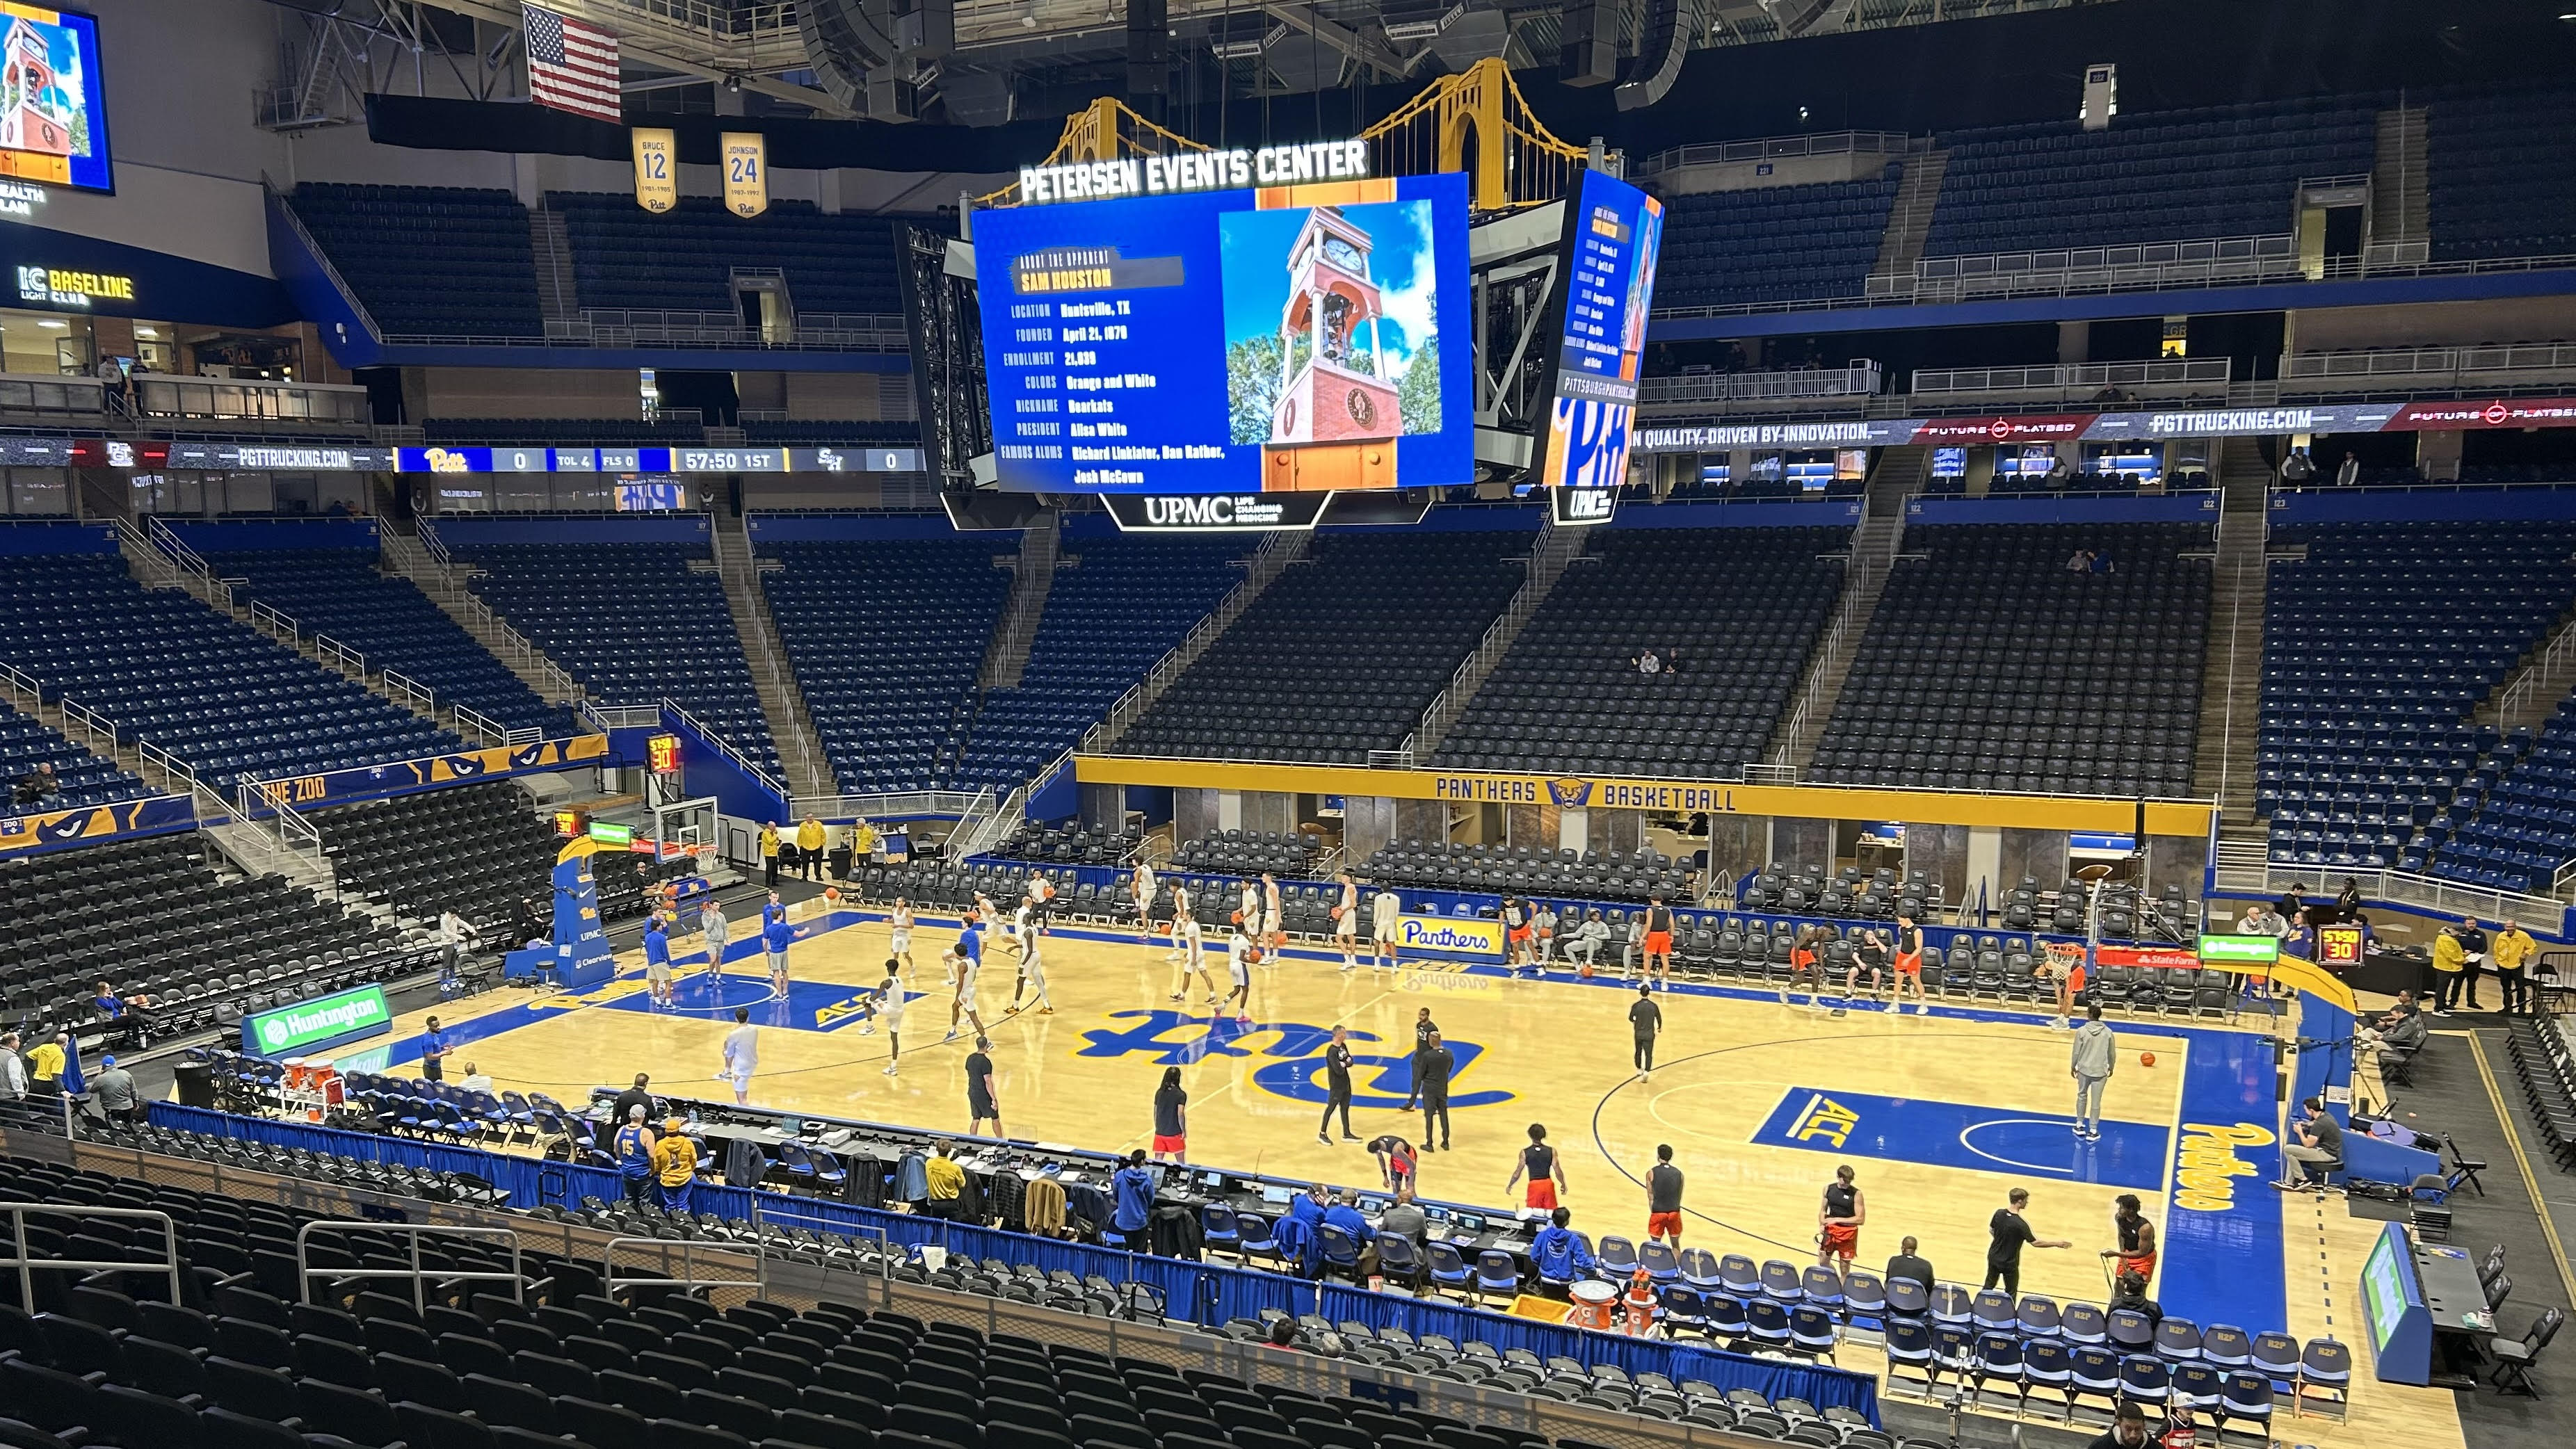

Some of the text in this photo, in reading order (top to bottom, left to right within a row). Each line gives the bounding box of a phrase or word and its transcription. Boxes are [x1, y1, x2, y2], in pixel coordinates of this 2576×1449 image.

[642, 142, 665, 151] BRUCE
[727, 147, 758, 155] JOHNSON
[643, 153, 666, 179] 12
[730, 157, 757, 183] 24
[1020, 140, 1369, 202] PETERSEN EVENTS CENTER
[647, 199, 666, 209] Pitt
[737, 203, 755, 213] Pitt
[1067, 250, 1109, 266] OPPONENT
[49, 269, 134, 299] BASELINE
[1021, 268, 1111, 291] SAM HOUSTON
[20, 291, 47, 300] LIGHT
[1011, 303, 1051, 318] LOCATION
[1061, 300, 1131, 318] Huntsville, TX
[1016, 327, 1052, 342] FOUNDED
[1063, 327, 1086, 343] April
[1088, 326, 1103, 342] 21,
[1004, 351, 1054, 366] ENROLLMENT
[1025, 375, 1057, 389] COLORS
[1066, 373, 1157, 391] Orange and White
[1015, 399, 1058, 413] NICKNAME
[1068, 399, 1113, 413] Bearkats
[2153, 409, 2312, 434] PGTTRUCKING.COM
[2408, 411, 2481, 421] FUTURE
[1016, 422, 1060, 437] PRESIDENT
[1097, 422, 1127, 437] White
[1645, 428, 1705, 449] QUALITY.
[1707, 426, 1757, 445] DRIVEN
[1762, 426, 1778, 443] BY
[1783, 423, 1873, 442] INNOVATION.
[1929, 427, 1987, 435] FUTURE
[2013, 423, 2076, 433] FLATBED
[239, 448, 348, 467] PGTTRUCKING.COM
[1001, 446, 1063, 460] FAMOUS ALUMS
[1072, 444, 1225, 461] Richard Linklater, Dan Rather,
[424, 447, 468, 473] Pitt
[515, 453, 526, 469] 0
[558, 455, 590, 467] TOL 4
[603, 455, 634, 467] FLS 0
[686, 453, 736, 469] 57:50
[745, 454, 770, 467] 1ST
[886, 453, 896, 469] 0
[1074, 469, 1144, 485] Josh McCown
[1144, 496, 1255, 524] UPMC LIFE
[1235, 504, 1282, 514] CHANGING
[1235, 513, 1279, 523] MEDICINE
[652, 749, 671, 770] 30
[295, 775, 326, 802] ZOO
[1435, 777, 1737, 811] PANTHERS BASKETBALL
[581, 929, 602, 941] UPMC
[1401, 919, 1489, 950] Panthers
[2323, 930, 2359, 944] 57:50
[2330, 943, 2352, 959] 30
[582, 953, 613, 966] Clearview
[285, 998, 380, 1037] Huntington
[1073, 1008, 1520, 1111] Pitt
[1797, 1097, 1860, 1149] ACC
[622, 1139, 634, 1156] 15
[2174, 1122, 2276, 1211] Panthers
[1689, 1254, 1704, 1263] HP
[1941, 1291, 1958, 1301] HP
[1985, 1297, 2002, 1307] H2P
[1581, 1306, 1592, 1318] G
[2029, 1303, 2047, 1313] H2P
[1629, 1311, 1641, 1325] G
[2074, 1311, 2091, 1320] H2P
[2120, 1318, 2139, 1327] H2P
[2168, 1325, 2187, 1335] H2P
[2217, 1331, 2236, 1342] H2P
[1990, 1341, 2007, 1350] H2P
[2267, 1339, 2286, 1350] H2P
[2318, 1347, 2337, 1357] H2P
[2086, 1355, 2104, 1365] H2P
[2136, 1363, 2154, 1373] H2P
[2187, 1371, 2206, 1381] H2P
[2239, 1379, 2259, 1390] H2P
